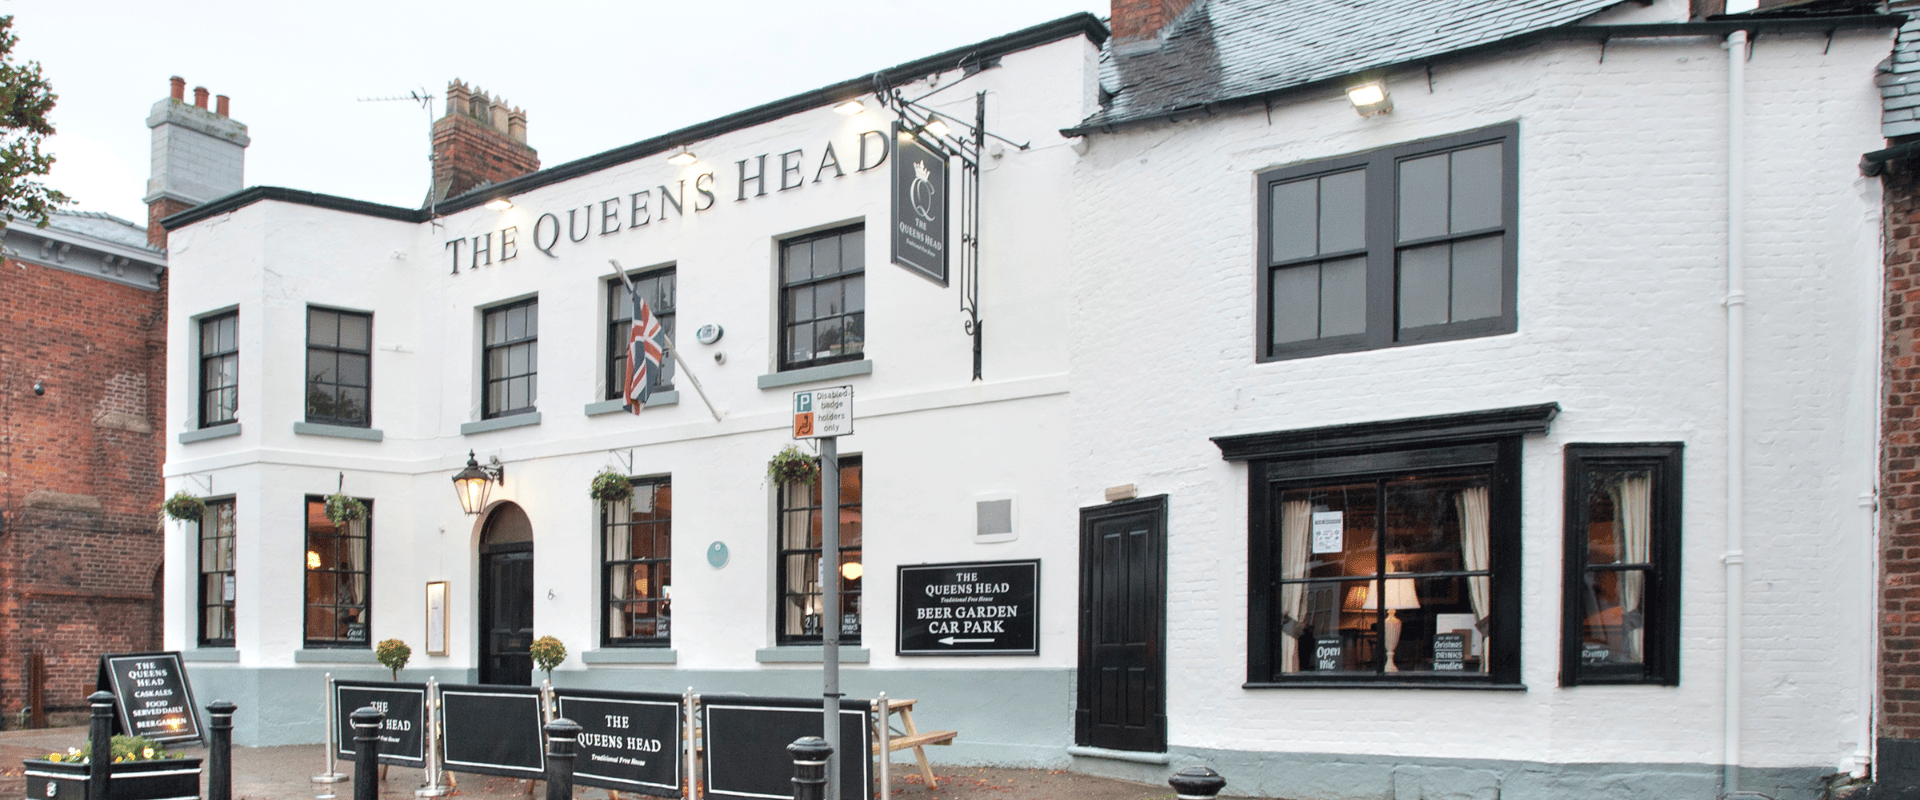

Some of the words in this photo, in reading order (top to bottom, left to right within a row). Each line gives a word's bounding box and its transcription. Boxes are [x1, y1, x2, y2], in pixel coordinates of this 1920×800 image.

[445, 225, 519, 275] THE
[532, 171, 716, 259] QUEENS
[734, 129, 890, 203] HEAD
[915, 217, 927, 231] THE
[899, 221, 925, 242] QUEENS
[924, 234, 942, 251] HEAD
[816, 389, 848, 400] Disabled
[801, 395, 811, 411] P
[821, 401, 843, 409] badge
[817, 413, 845, 421] holders
[823, 424, 840, 432] only
[956, 572, 978, 582] THE
[925, 584, 973, 598] QUEENS
[975, 583, 1010, 594] HEAD
[917, 607, 952, 619] BEER
[955, 605, 1018, 619] GARDEN
[928, 621, 960, 634] CAR
[963, 620, 1005, 634] PARK
[1316, 646, 1341, 660] Open
[1435, 651, 1463, 659] DRINKS
[135, 662, 156, 670] THE
[128, 669, 168, 680] QUEENS
[136, 678, 165, 687] HEAD
[145, 700, 168, 708] FOOD
[370, 701, 388, 712] THE
[386, 719, 411, 731] HEAD
[604, 714, 630, 729] THE
[577, 732, 623, 749] QUEENS
[626, 736, 662, 753] HEAD
